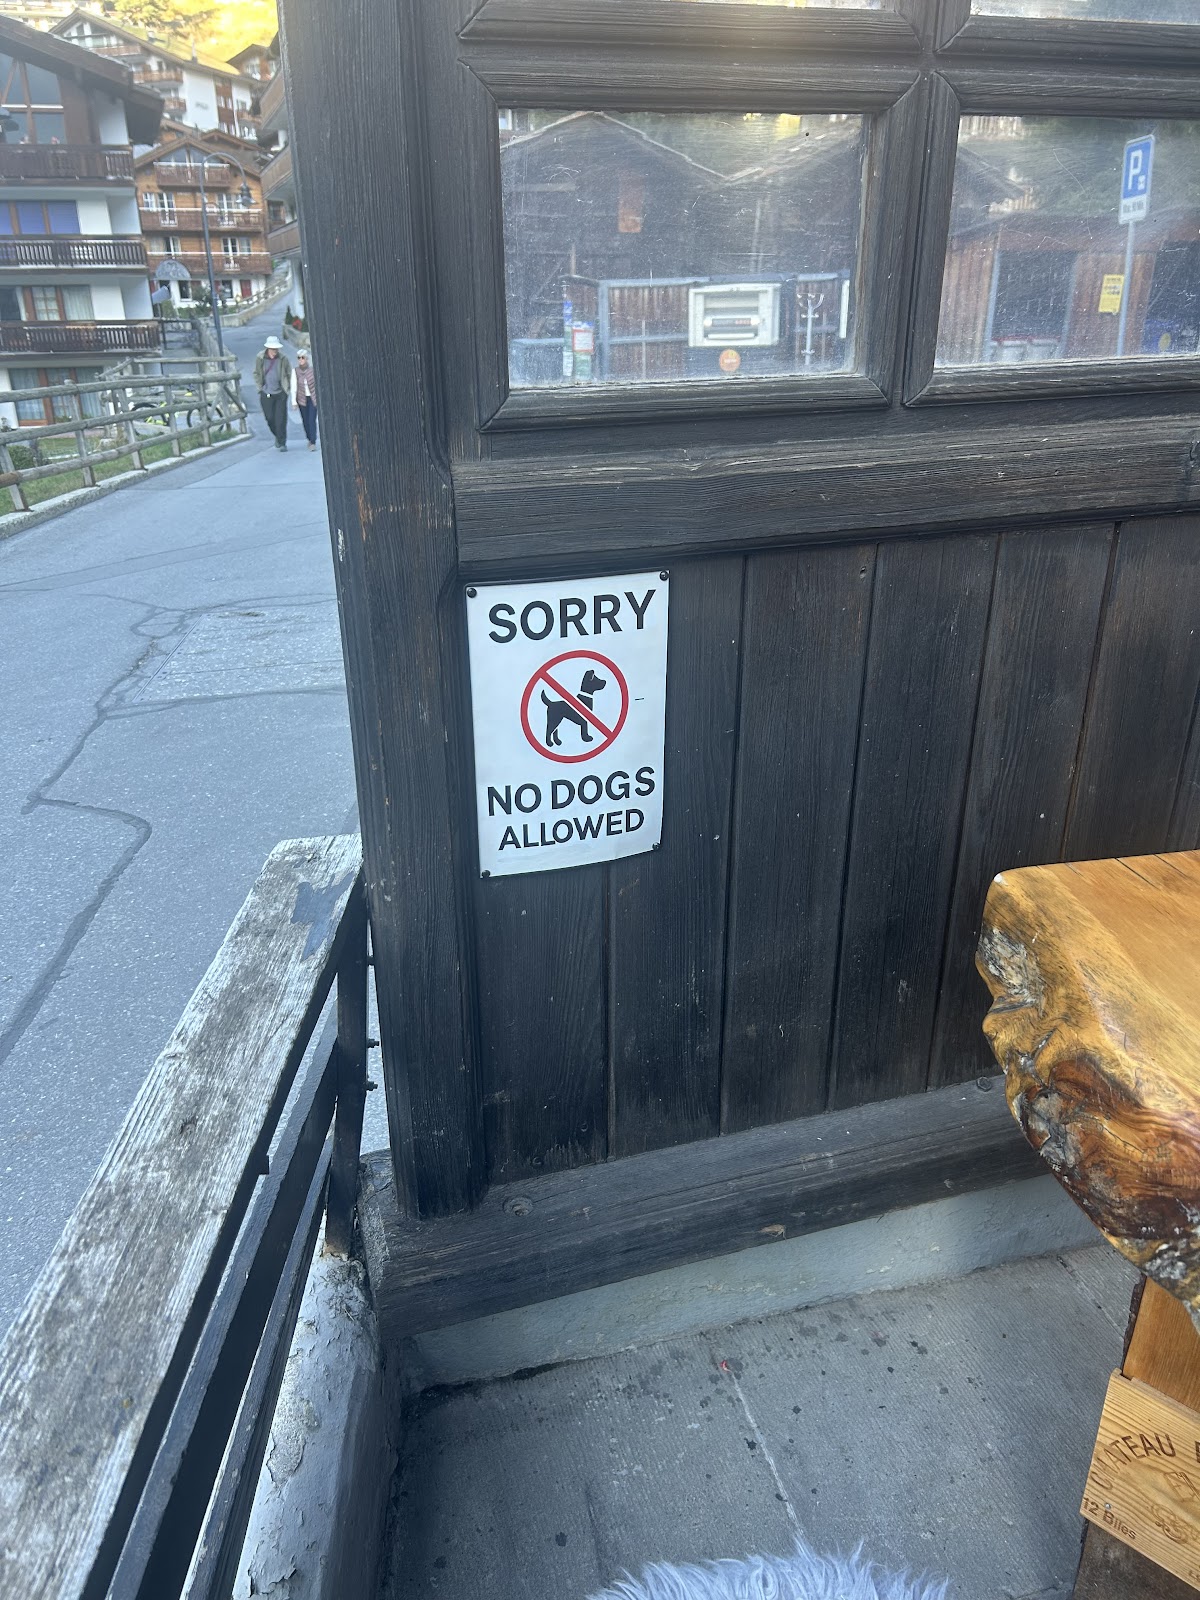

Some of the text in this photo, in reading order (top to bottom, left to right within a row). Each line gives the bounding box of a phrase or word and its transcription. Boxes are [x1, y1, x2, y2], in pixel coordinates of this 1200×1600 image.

[1128, 149, 1143, 190] P
[488, 589, 656, 643] SORRY
[487, 766, 656, 816] NO DOGS
[498, 808, 645, 850] ALLOWED
[1083, 1497, 1099, 1516] 12
